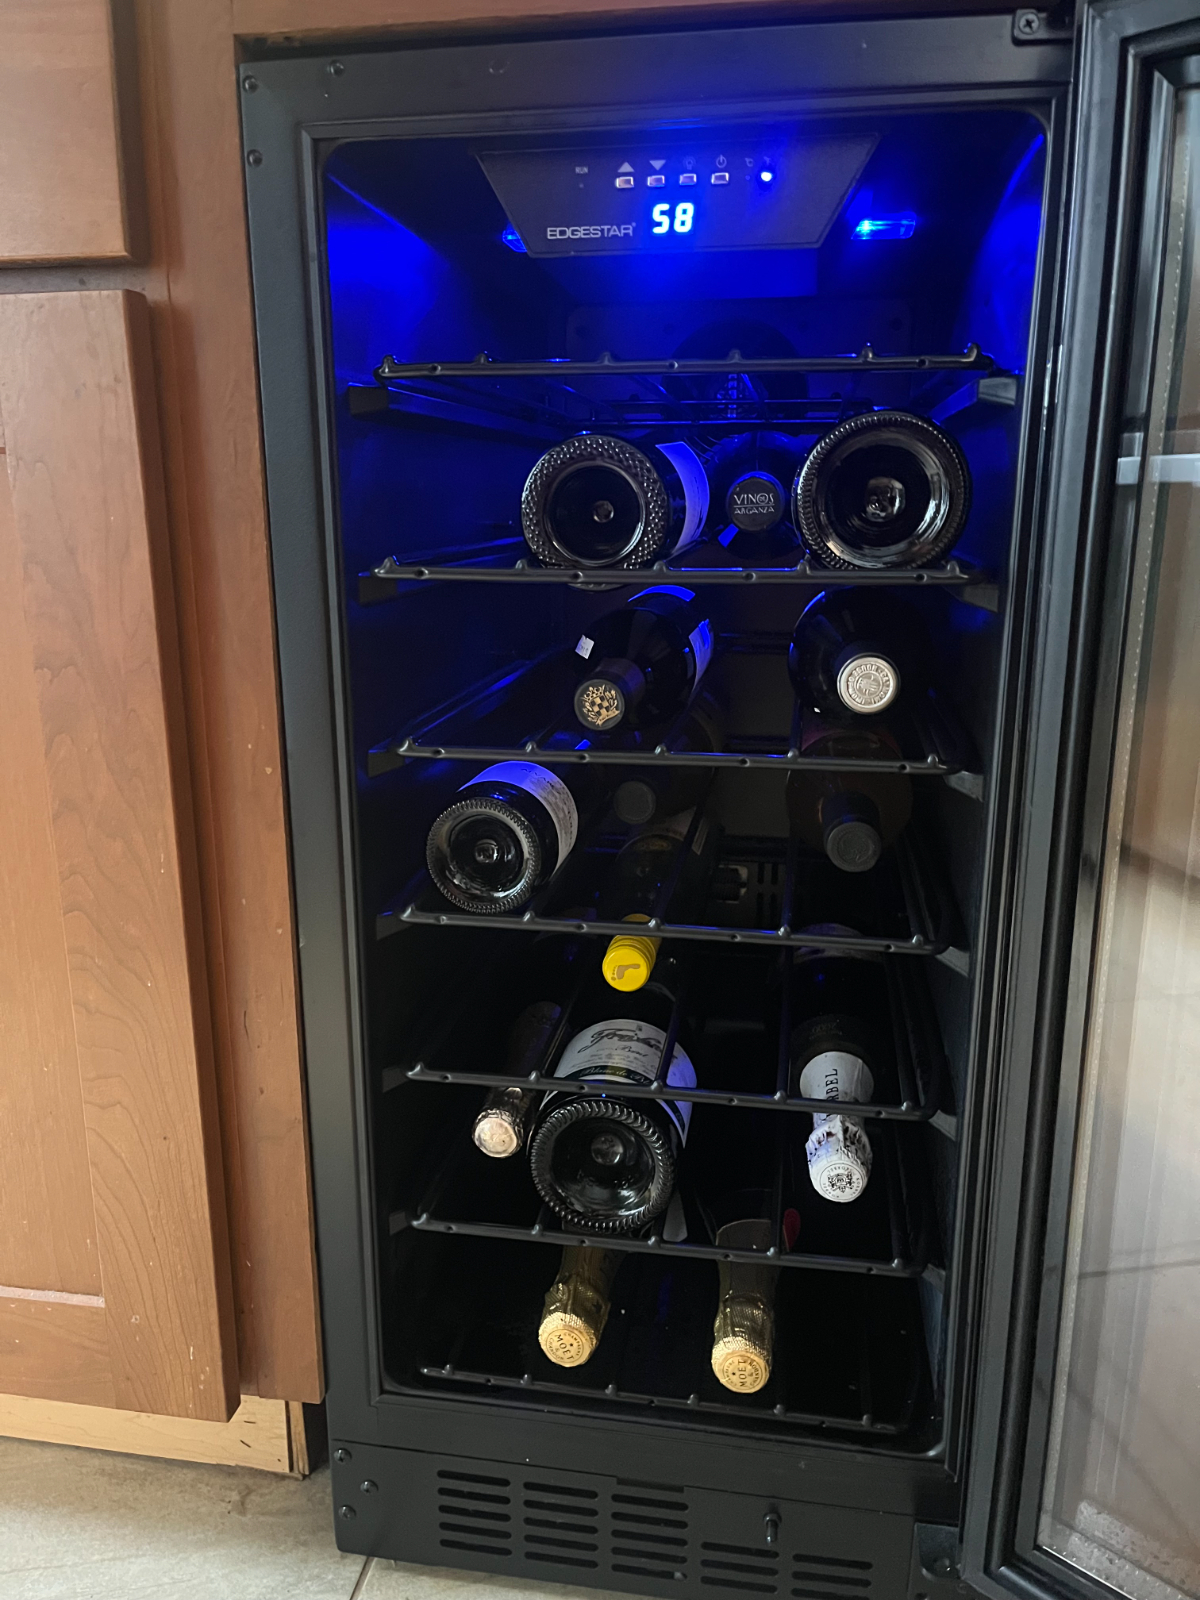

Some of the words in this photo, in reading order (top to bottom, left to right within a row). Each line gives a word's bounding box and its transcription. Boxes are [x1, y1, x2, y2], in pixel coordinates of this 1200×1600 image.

[575, 166, 588, 174] RUN
[652, 203, 695, 233] 58
[547, 225, 634, 239] EDGESTAR
[733, 493, 775, 505] VINOS
[734, 506, 775, 515] ARGANZA
